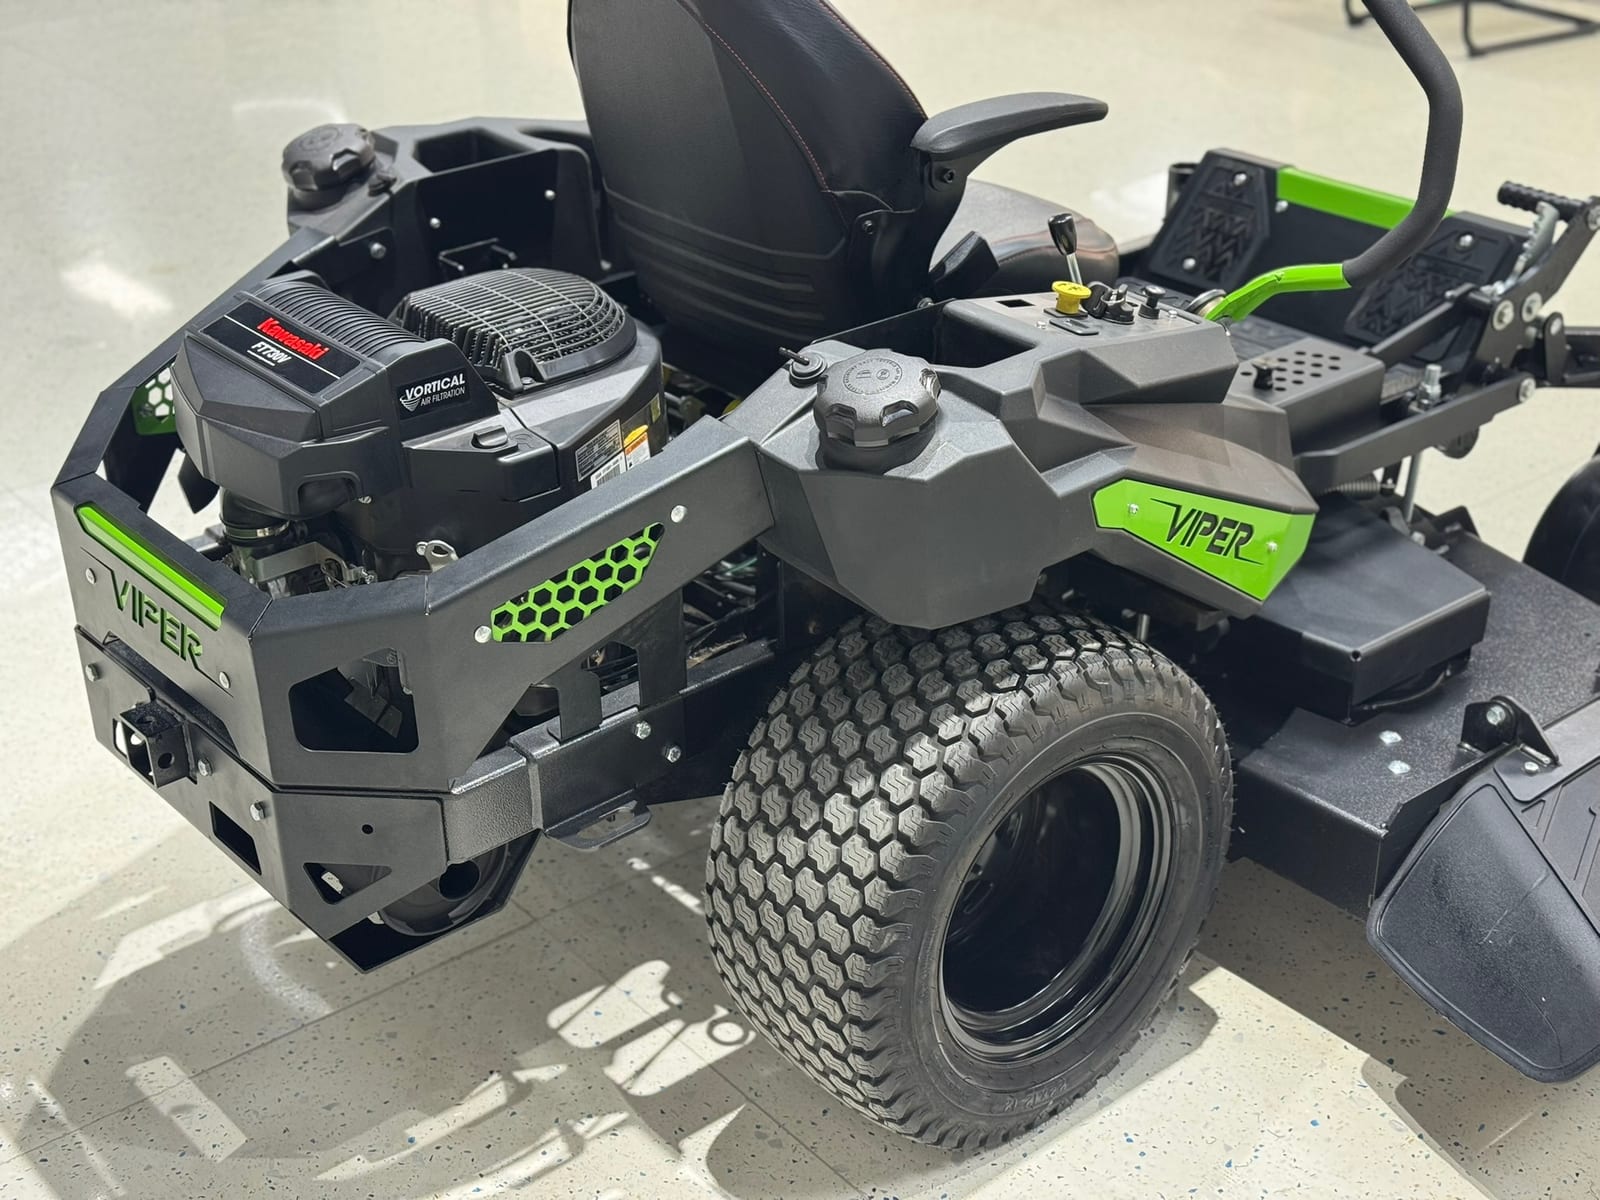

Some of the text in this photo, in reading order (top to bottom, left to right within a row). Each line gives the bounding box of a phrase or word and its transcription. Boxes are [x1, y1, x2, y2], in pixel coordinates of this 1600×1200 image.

[251, 341, 292, 363] FT730V
[257, 317, 330, 360] Kawasaki
[405, 373, 466, 400] VORTICAL
[420, 386, 466, 407] AIR FILTRATION
[1150, 498, 1264, 565] VIPER
